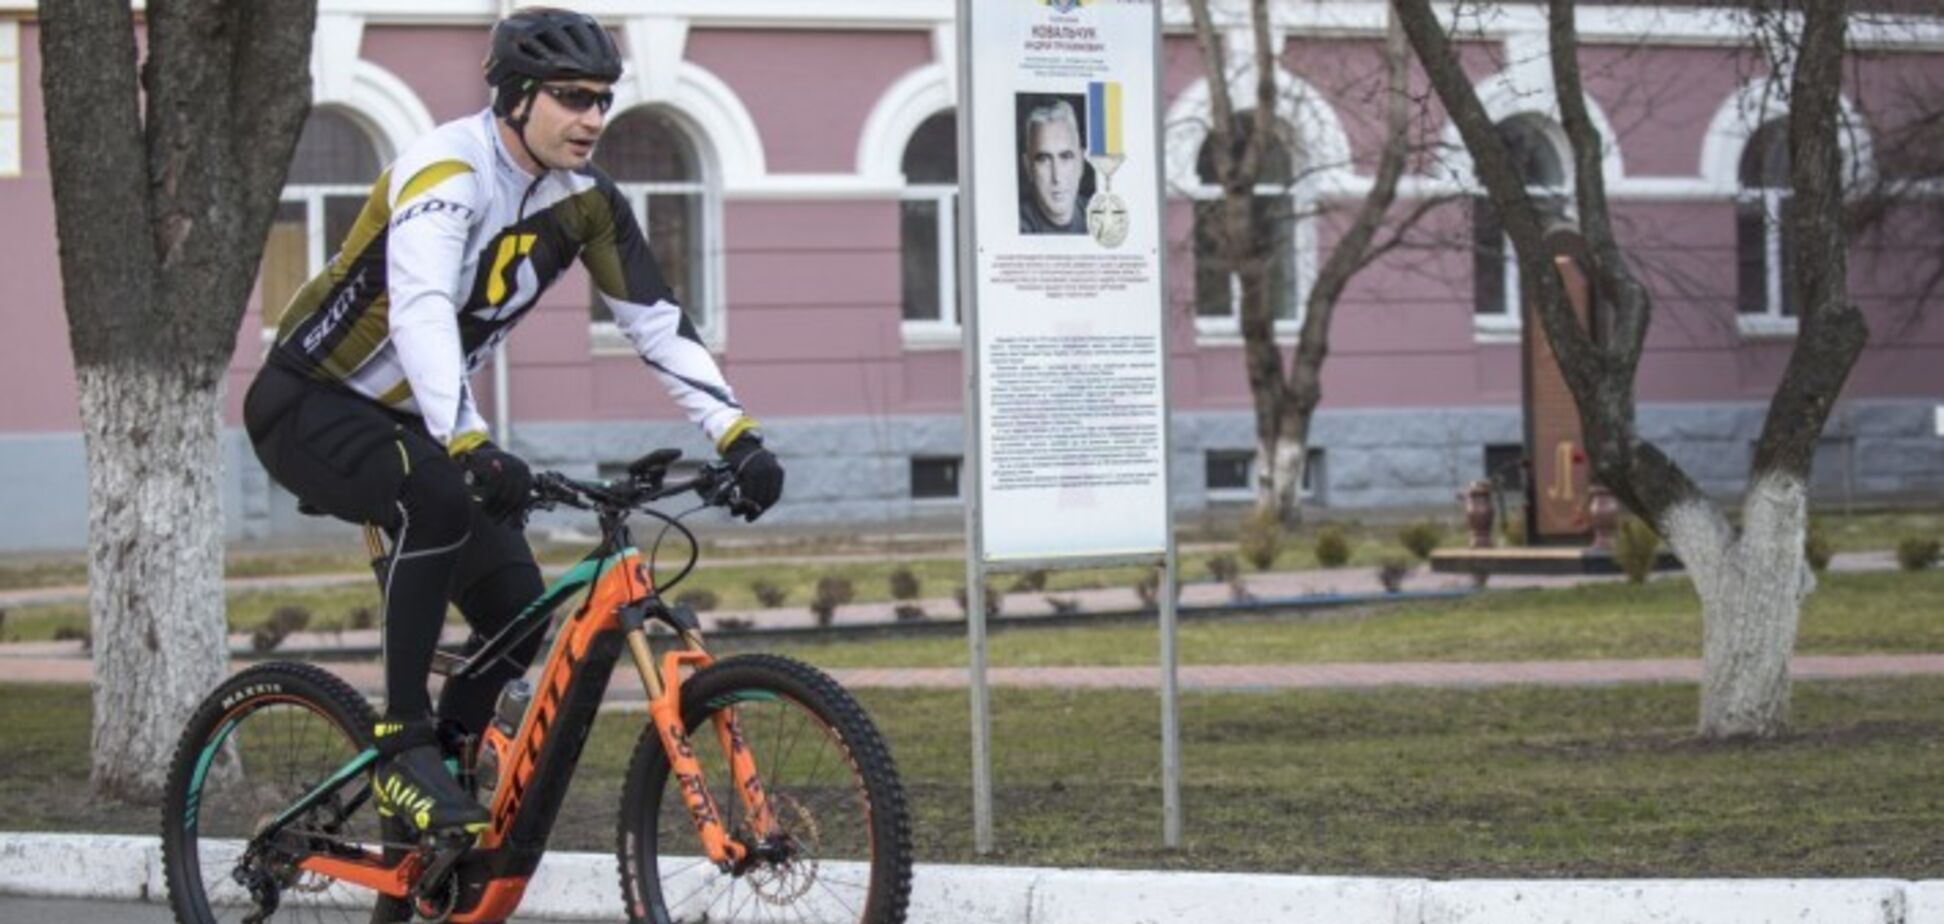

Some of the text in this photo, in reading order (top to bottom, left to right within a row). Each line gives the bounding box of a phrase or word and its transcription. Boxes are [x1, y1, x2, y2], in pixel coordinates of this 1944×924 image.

[391, 198, 475, 229] SCOTT
[302, 266, 369, 355] SCOTT
[221, 682, 283, 709] MAXXIS
